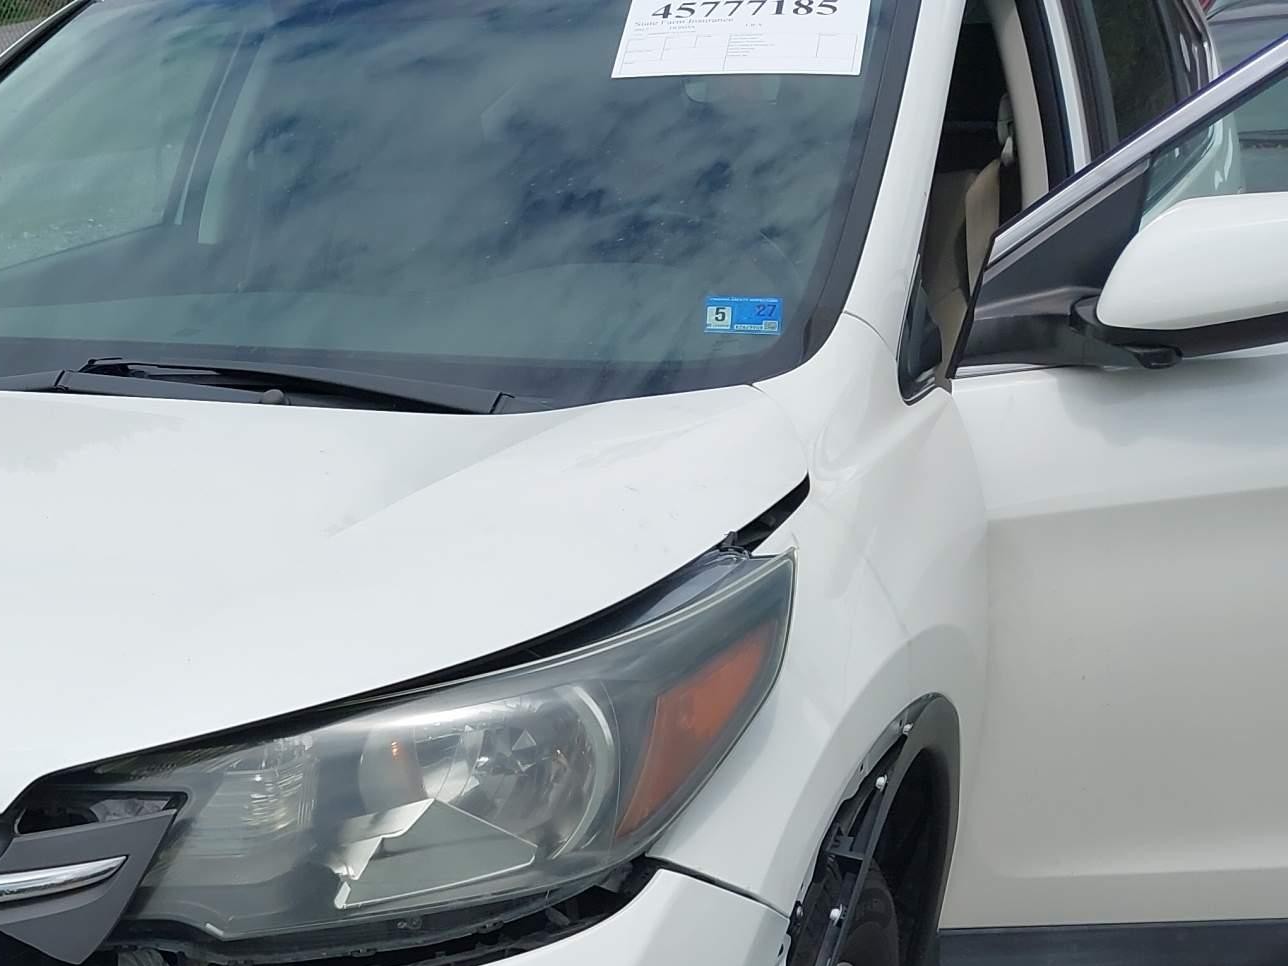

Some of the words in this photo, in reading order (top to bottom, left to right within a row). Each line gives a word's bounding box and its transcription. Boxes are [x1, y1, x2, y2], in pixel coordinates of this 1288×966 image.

[652, 0, 838, 19] 45777185
[715, 307, 726, 321] 5
[756, 304, 777, 317] 27
